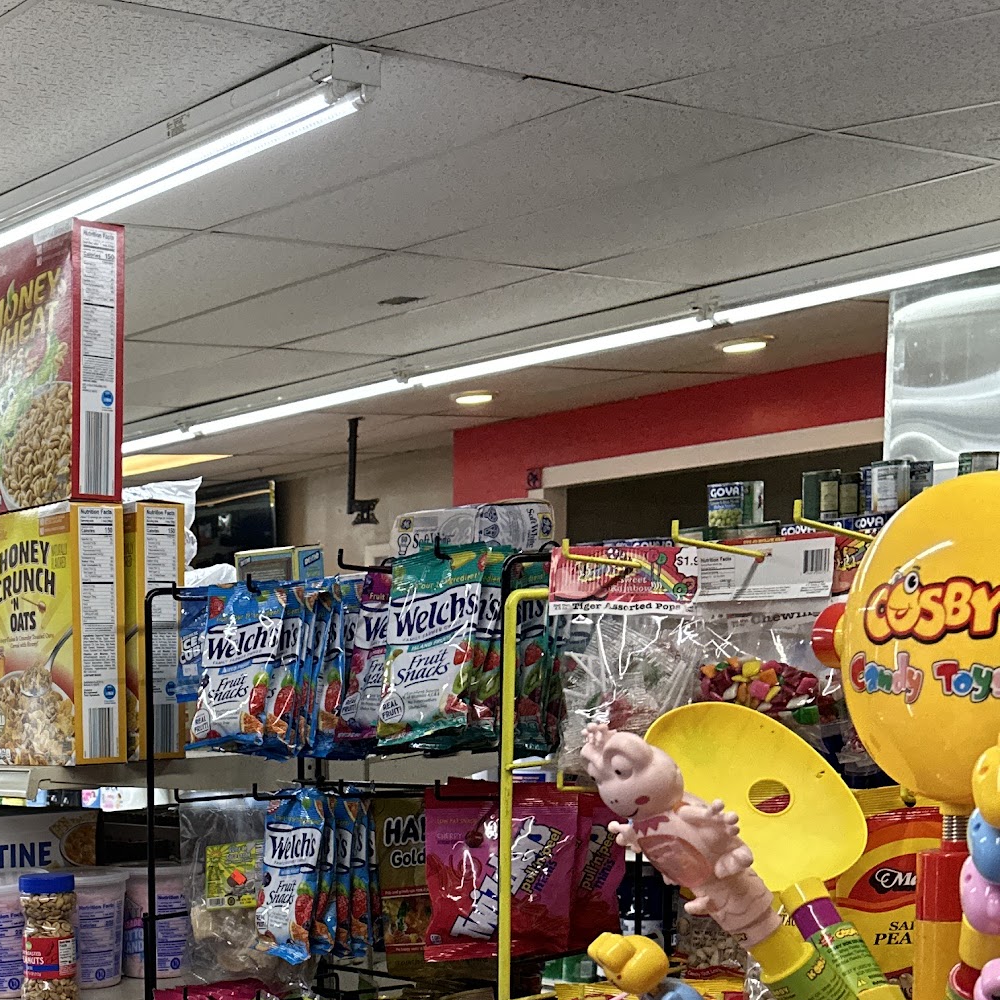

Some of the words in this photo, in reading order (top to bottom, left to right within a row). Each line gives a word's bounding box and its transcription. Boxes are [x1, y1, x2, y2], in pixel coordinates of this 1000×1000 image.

[710, 486, 740, 498] GOYA
[0, 540, 50, 574] HONEY
[394, 591, 478, 638] Welch's
[605, 603, 652, 611] Assorted
[656, 603, 680, 611] Pops
[864, 576, 1000, 645] COSBY
[10, 612, 36, 632] OATS
[410, 649, 448, 669] Fruit
[217, 674, 247, 692] Fruit
[395, 663, 450, 686] Snacks
[851, 651, 924, 703] Candy
[382, 699, 398, 710] REAL
[382, 707, 401, 720] FRUIT!
[195, 717, 206, 727] REAL
[270, 831, 317, 861] Welch's
[276, 880, 296, 898] Fruit
